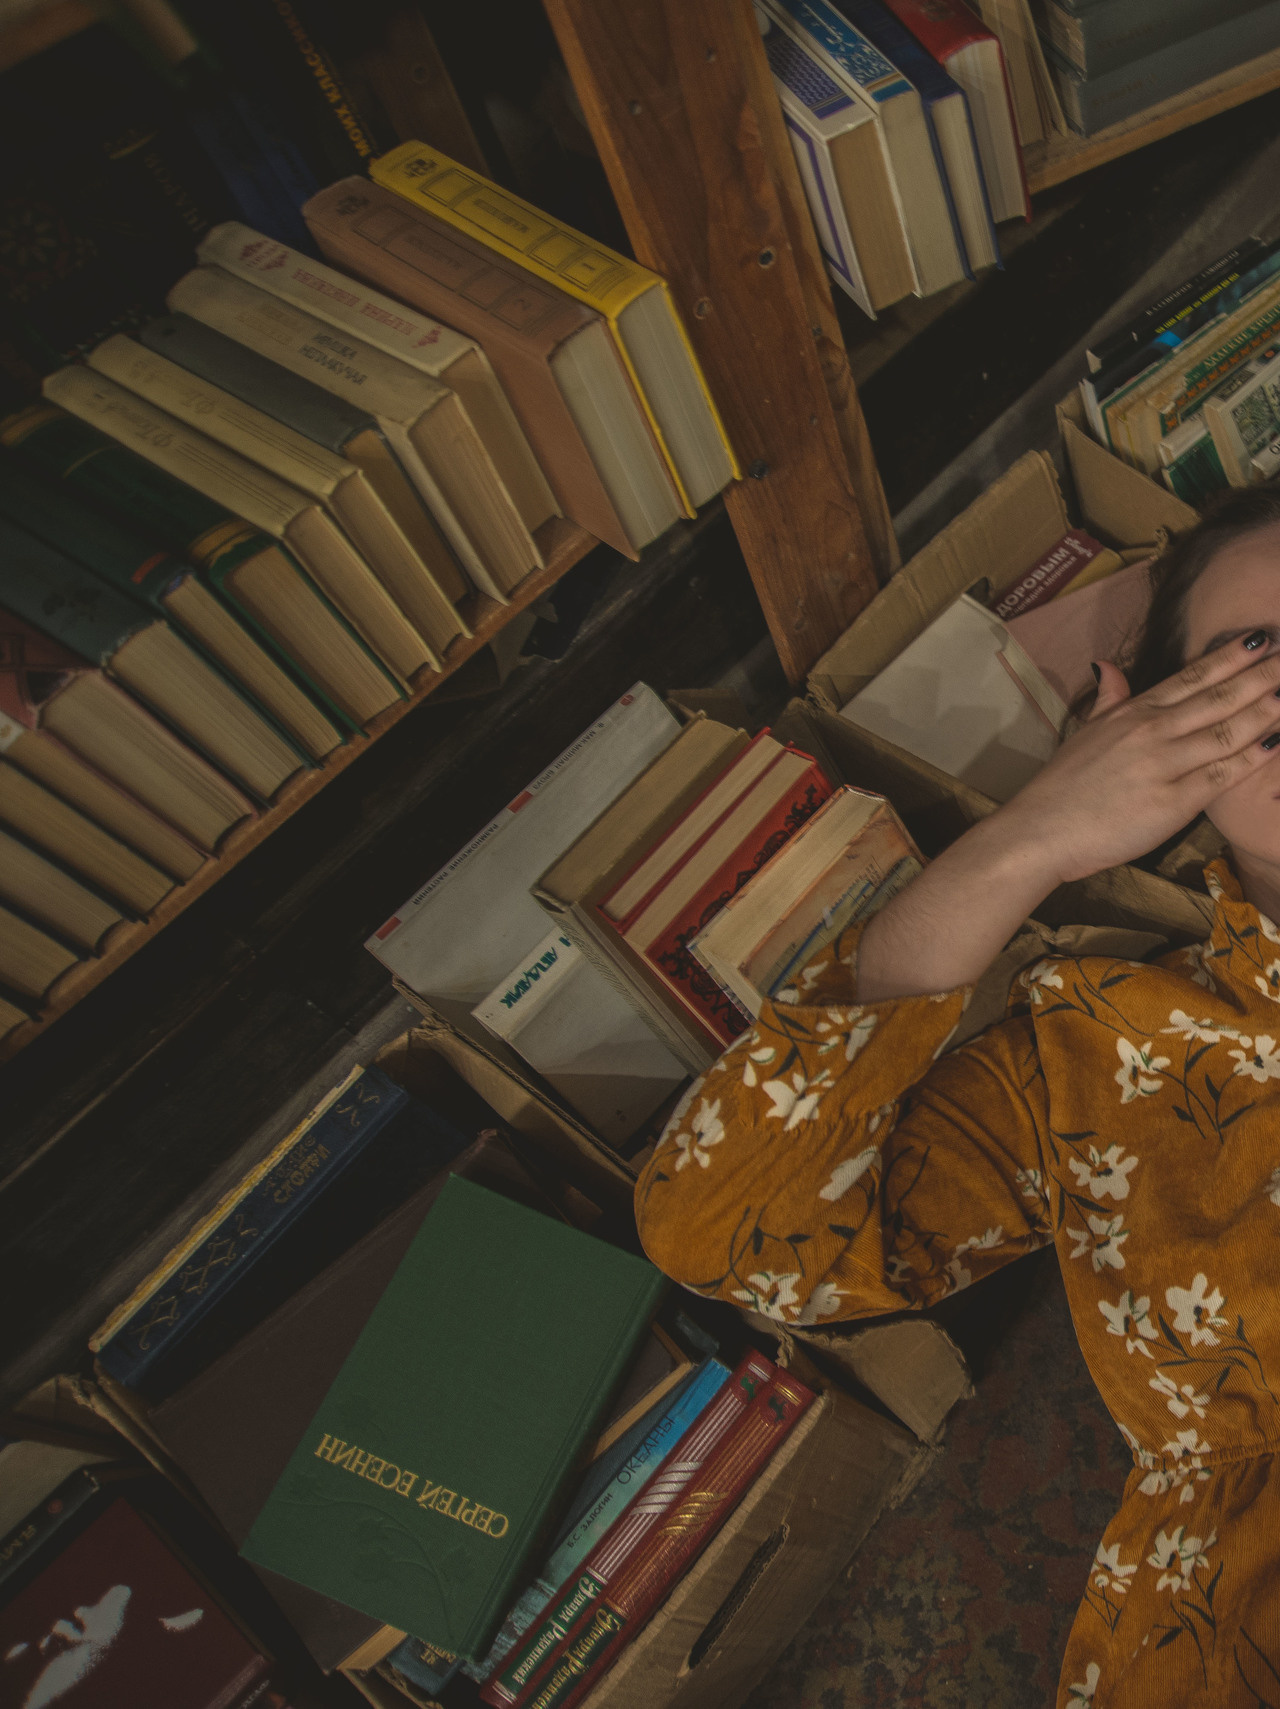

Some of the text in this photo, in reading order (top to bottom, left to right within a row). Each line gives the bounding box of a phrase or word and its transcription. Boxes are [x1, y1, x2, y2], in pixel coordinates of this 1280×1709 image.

[273, 0, 372, 159] МОИХ КЛАССИКО
[996, 547, 1070, 618] ДОРОВЫМ
[412, 823, 499, 907] РАЗМНОЖЕНИЕ РАСТЕНИЙ
[314, 1434, 509, 1540] СЕРГЕЙ ЕСЕНИН
[616, 1414, 675, 1486] ОКЕАНЫ
[566, 1493, 613, 1550] Б.С. ЗАЛОГИН
[512, 1577, 601, 1685] Эдвард Радзинский
[574, 1608, 622, 1662] Эдвард
